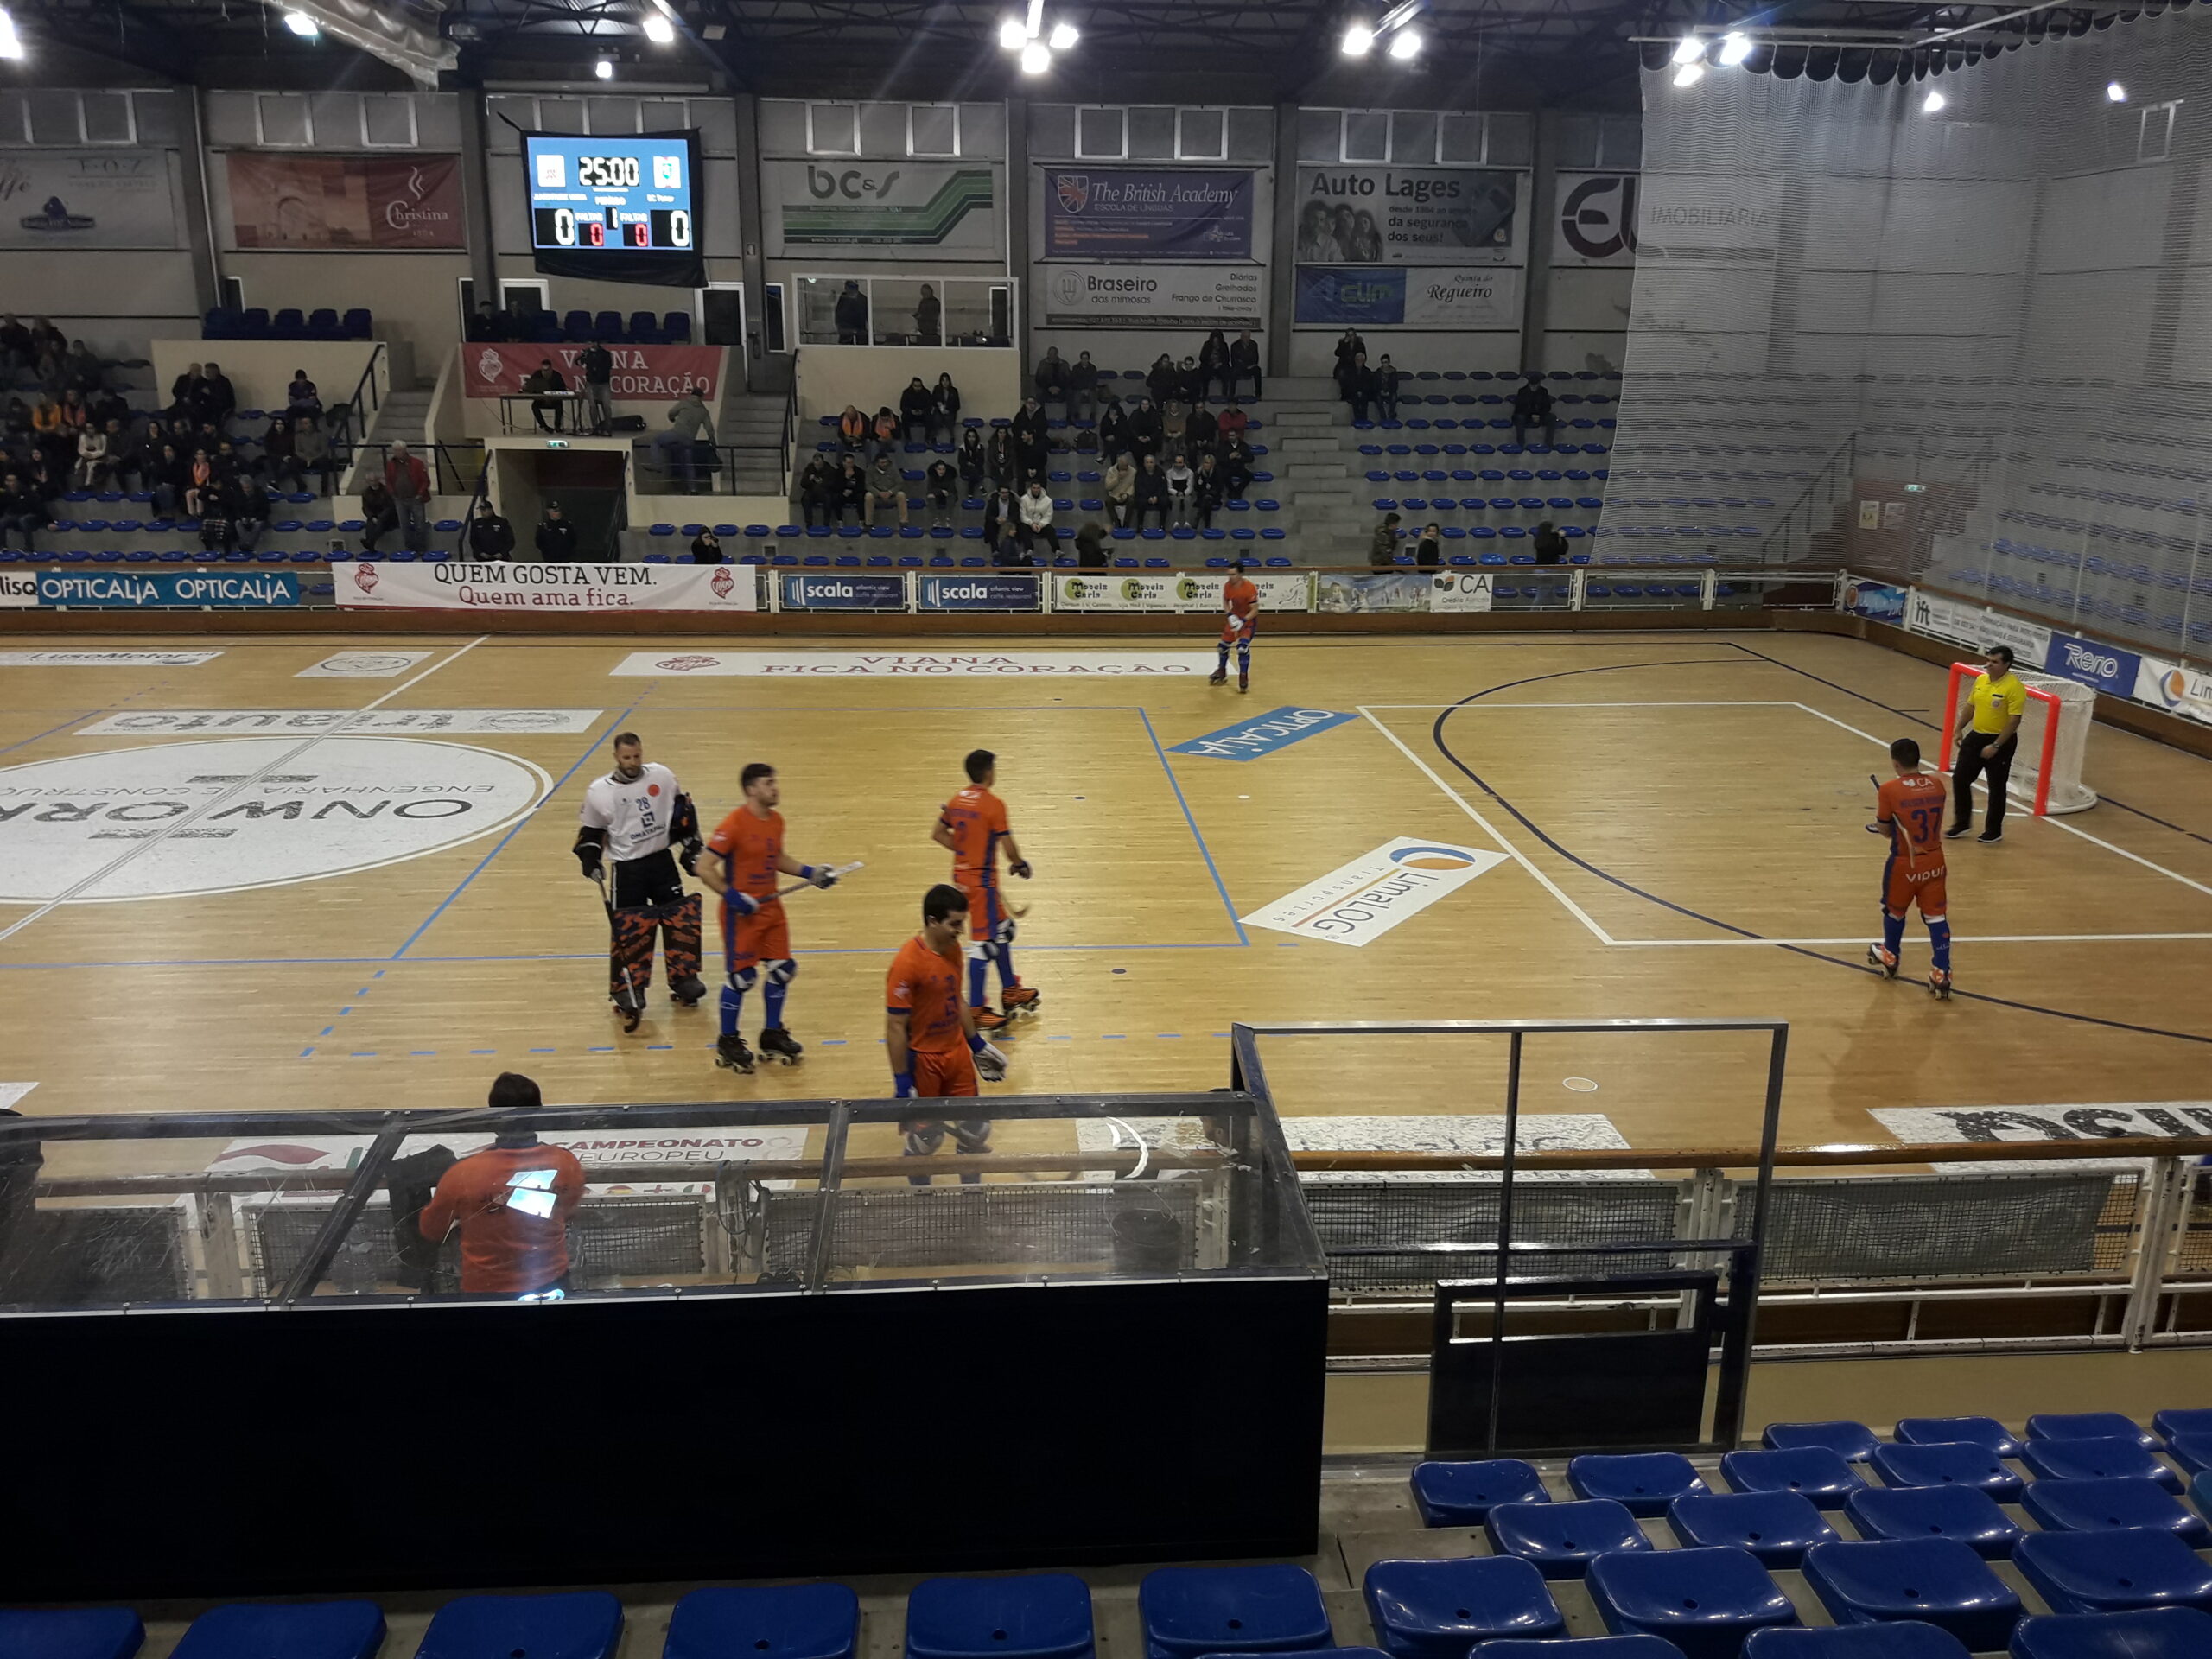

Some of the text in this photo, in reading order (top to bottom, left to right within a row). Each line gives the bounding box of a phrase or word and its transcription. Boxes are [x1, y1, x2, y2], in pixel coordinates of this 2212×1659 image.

[579, 156, 639, 187] 25:00
[1093, 182, 1238, 209] The British Academy
[1310, 173, 1460, 203] Auto Lages
[386, 200, 449, 229] Christina
[1389, 216, 1403, 226] da
[555, 208, 575, 246] 0
[671, 210, 690, 247] 0
[590, 223, 603, 246] 0
[635, 223, 648, 247] 0
[1388, 231, 1408, 241] dos
[1087, 276, 1158, 292] Braseiro
[1427, 283, 1493, 304] Regueiro
[1091, 295, 1151, 304] das mimosas
[1171, 294, 1200, 303] Frango
[1215, 294, 1257, 303] Churrasco
[434, 563, 658, 587] QUEM GOSTA VEM.
[1460, 575, 1491, 594] CA
[458, 585, 634, 607] Quem ama fica.
[806, 582, 854, 599] scala
[942, 583, 988, 600] scala
[855, 655, 1022, 664] VIANA
[2063, 643, 2119, 678] Reno
[761, 663, 1192, 676] FICA NO CORAÇÃO
[262, 785, 495, 796] ENGENHARIA
[1916, 778, 1934, 787] CA
[635, 797, 651, 811] 28
[1910, 807, 1942, 844] 37
[1273, 866, 1385, 923] Transportes
[580, 1150, 725, 1162] EUROPEU
